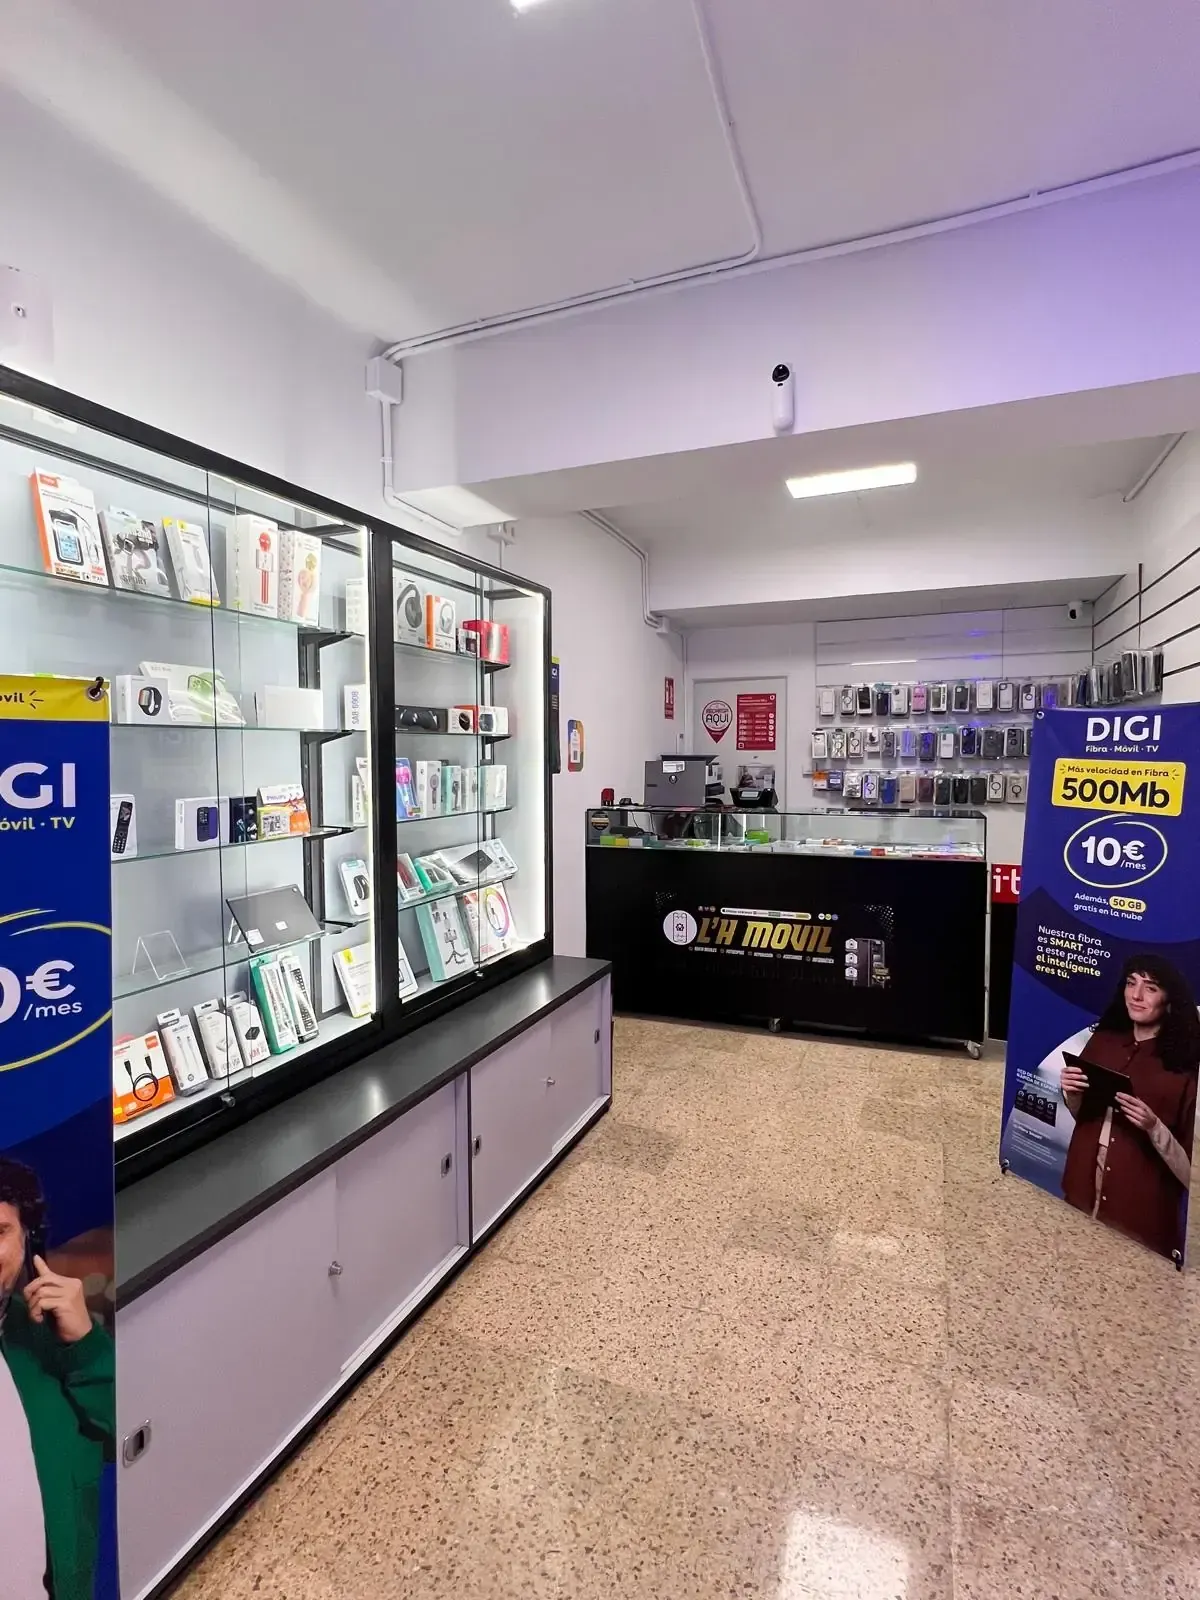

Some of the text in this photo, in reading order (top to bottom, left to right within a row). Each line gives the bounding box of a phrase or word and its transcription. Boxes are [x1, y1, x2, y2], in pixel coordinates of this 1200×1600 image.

[1086, 715, 1162, 741] DIGI
[1085, 744, 1159, 753] Fibra Móvil TV
[1067, 765, 1085, 773] Más
[1086, 766, 1129, 776] velocidad
[1144, 769, 1170, 778] Fibra
[1061, 777, 1170, 809] 500Mb
[50, 816, 76, 829] TV
[1081, 835, 1146, 867] 10€
[1120, 860, 1147, 870] /mes
[1074, 892, 1142, 910] Además, 50 GB
[1073, 903, 1143, 921] gratis en la nube
[1038, 925, 1103, 946] Nuestra fibra
[1037, 936, 1111, 959] es SMART, pero
[1045, 947, 1066, 958] este
[1067, 952, 1098, 966] precio
[1035, 964, 1070, 979] eres tú.
[1036, 954, 1101, 977] el inteligente
[23, 1001, 83, 1021] /mes
